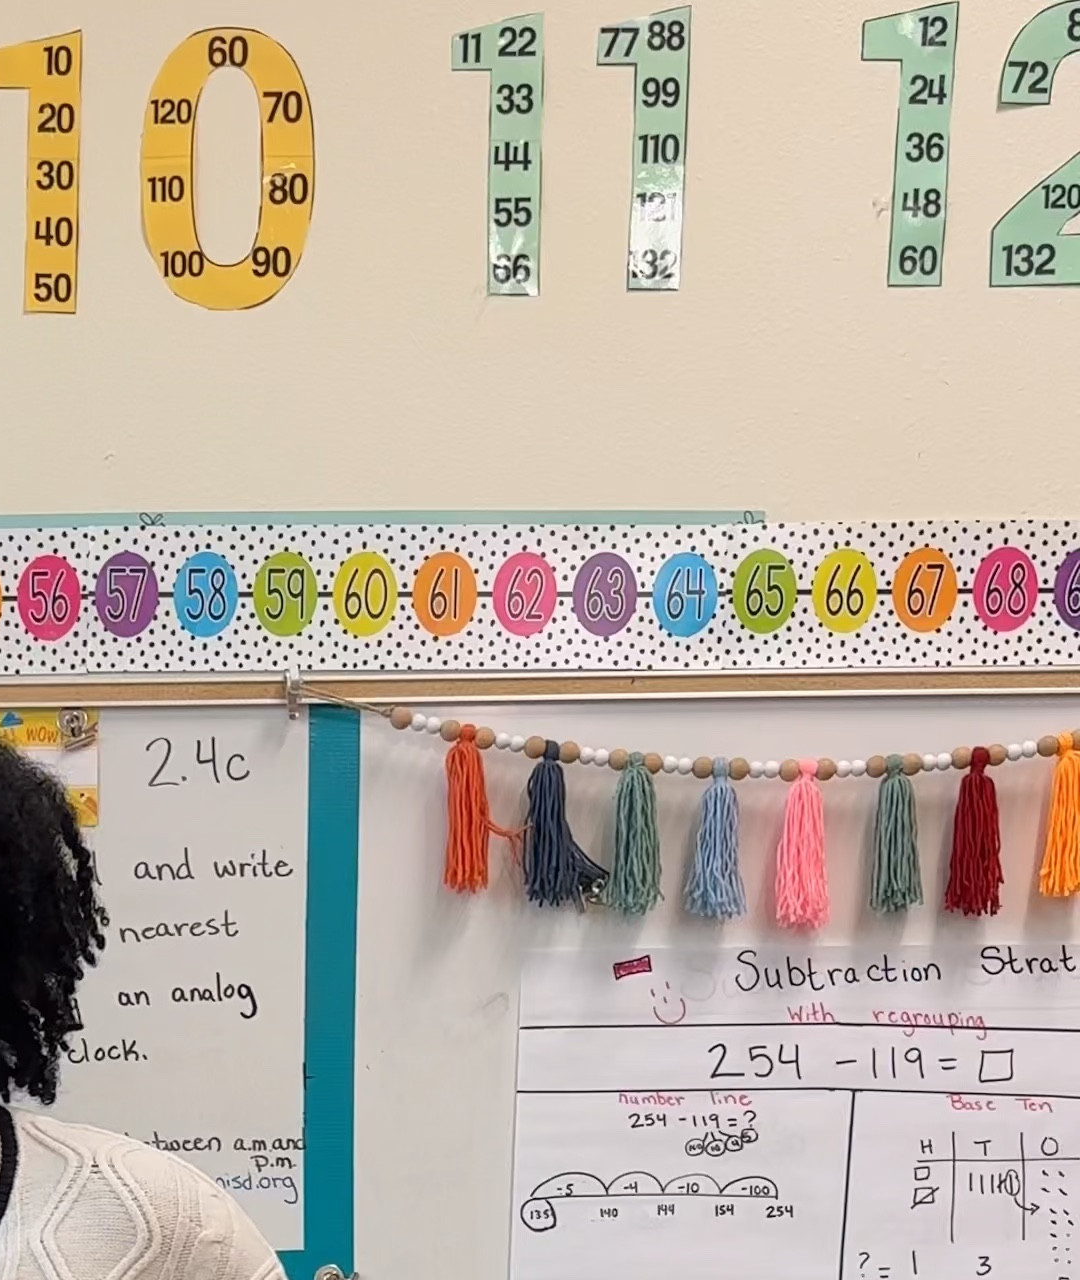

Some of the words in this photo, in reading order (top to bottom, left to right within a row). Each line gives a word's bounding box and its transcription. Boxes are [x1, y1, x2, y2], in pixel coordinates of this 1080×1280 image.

[497, 27, 537, 57] 22
[908, 75, 947, 106] 24
[149, 99, 192, 125] 120
[638, 134, 680, 163] 110
[36, 161, 75, 190] 30
[268, 174, 309, 205] 80
[493, 198, 533, 228] 55
[901, 188, 942, 219] 48
[1001, 244, 1057, 276] 132
[28, 571, 70, 625] 56
[263, 568, 306, 621] 59
[506, 567, 544, 622] 62
[745, 563, 786, 616] 65
[984, 562, 1026, 616] 68
[133, 848, 195, 881] and
[213, 849, 295, 879] write
[119, 909, 240, 943] nearest
[735, 949, 942, 991] Subtraction
[118, 988, 151, 1007] an
[171, 972, 258, 1019] analog
[872, 1009, 987, 1041] regrouping
[707, 1043, 802, 1080] 254
[619, 1092, 685, 1107] number
[711, 1091, 753, 1107] line
[946, 1094, 997, 1111] Base
[1015, 1098, 1054, 1113] Ten
[628, 1112, 668, 1129] 254
[920, 1138, 933, 1154] H
[973, 1139, 992, 1156] T
[1040, 1136, 1060, 1157] O
[529, 1209, 550, 1221] 135
[599, 1207, 618, 1219] 140
[657, 1204, 675, 1216] 144
[715, 1204, 734, 1217] 154
[766, 1205, 794, 1218] 254
